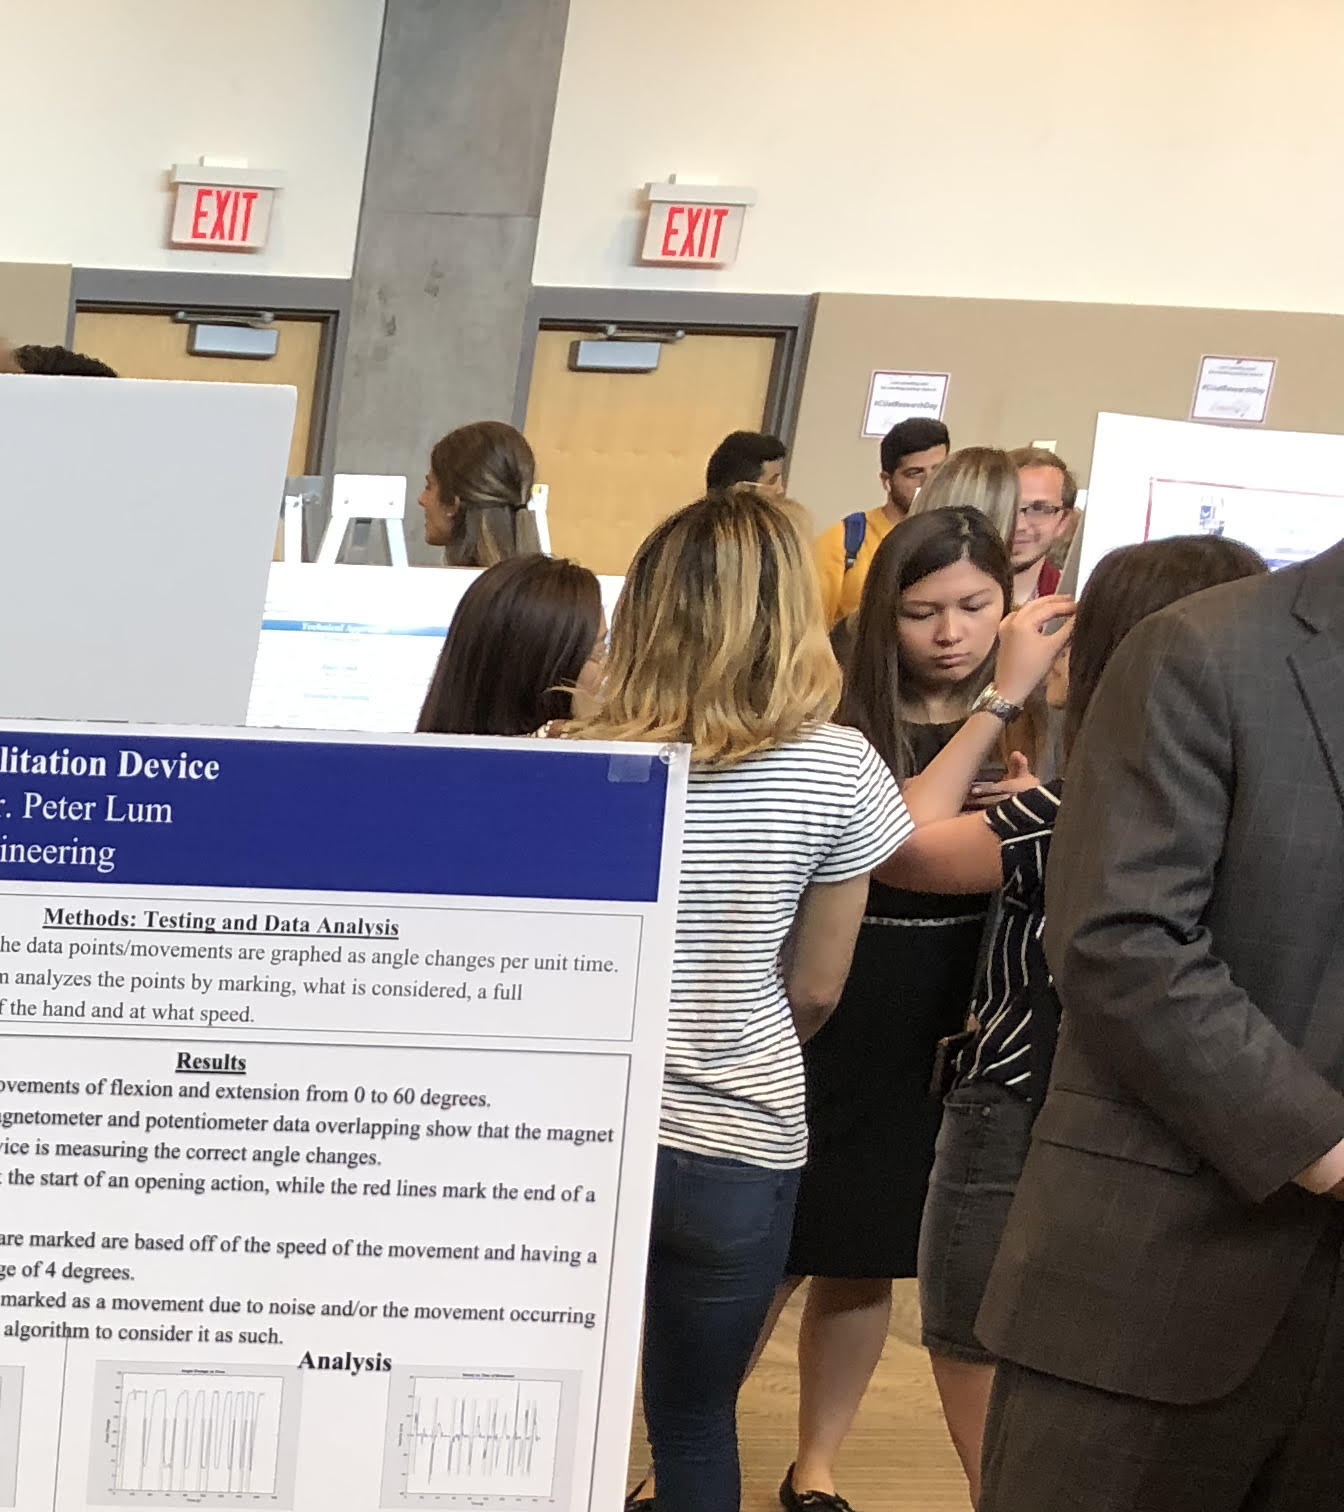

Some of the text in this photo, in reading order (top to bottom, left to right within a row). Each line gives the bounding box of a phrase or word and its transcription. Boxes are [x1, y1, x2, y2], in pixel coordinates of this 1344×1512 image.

[192, 188, 259, 242] EXIT
[662, 206, 729, 259] EXIT
[117, 750, 220, 780] Device
[22, 792, 97, 821] Peter
[104, 795, 173, 824] Lum
[43, 907, 399, 937] Methods: Testing and Data Analysis
[176, 1052, 246, 1071] Results
[21, 1260, 44, 1278] of
[45, 1261, 57, 1278] 4
[61, 1261, 135, 1284] degrees.
[296, 1351, 392, 1377] Analysis
